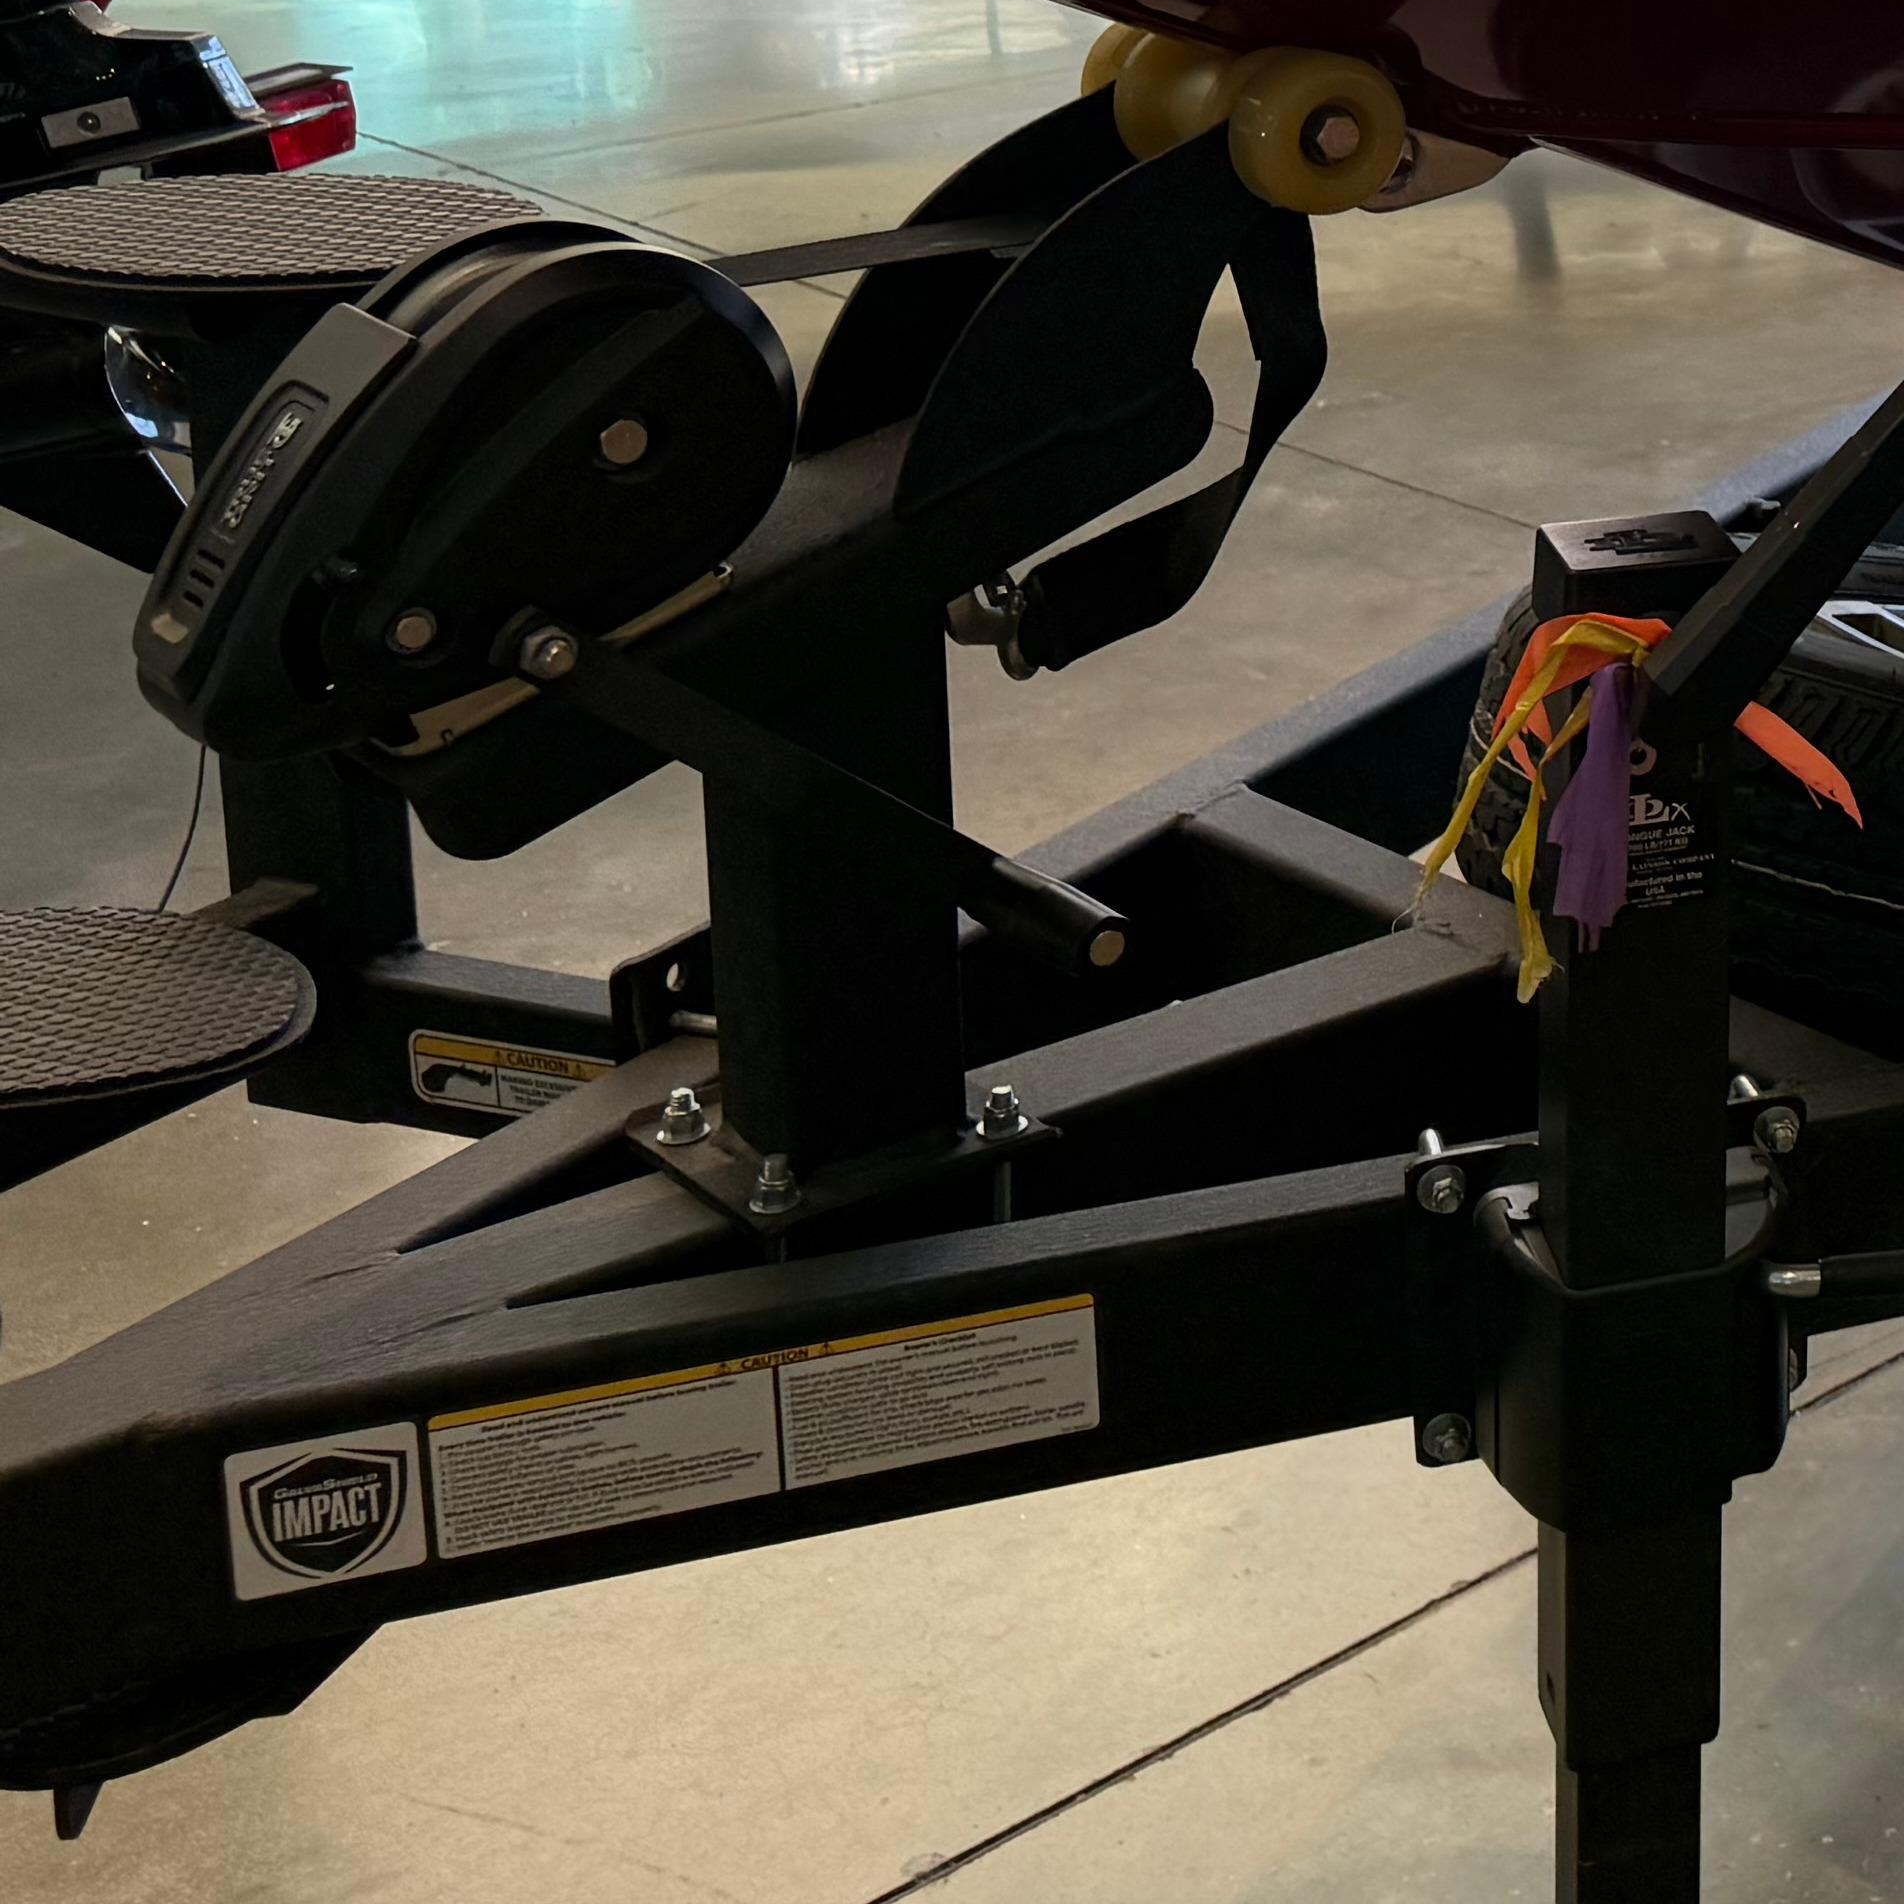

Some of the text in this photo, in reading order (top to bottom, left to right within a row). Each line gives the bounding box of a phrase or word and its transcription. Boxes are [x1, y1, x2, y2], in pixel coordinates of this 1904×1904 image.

[1666, 824, 1696, 838] JACK
[1645, 885, 1665, 896] USA
[506, 1052, 569, 1074] CAUTION
[741, 1349, 809, 1370] CAUTION
[272, 1482, 382, 1542] IMPACT
